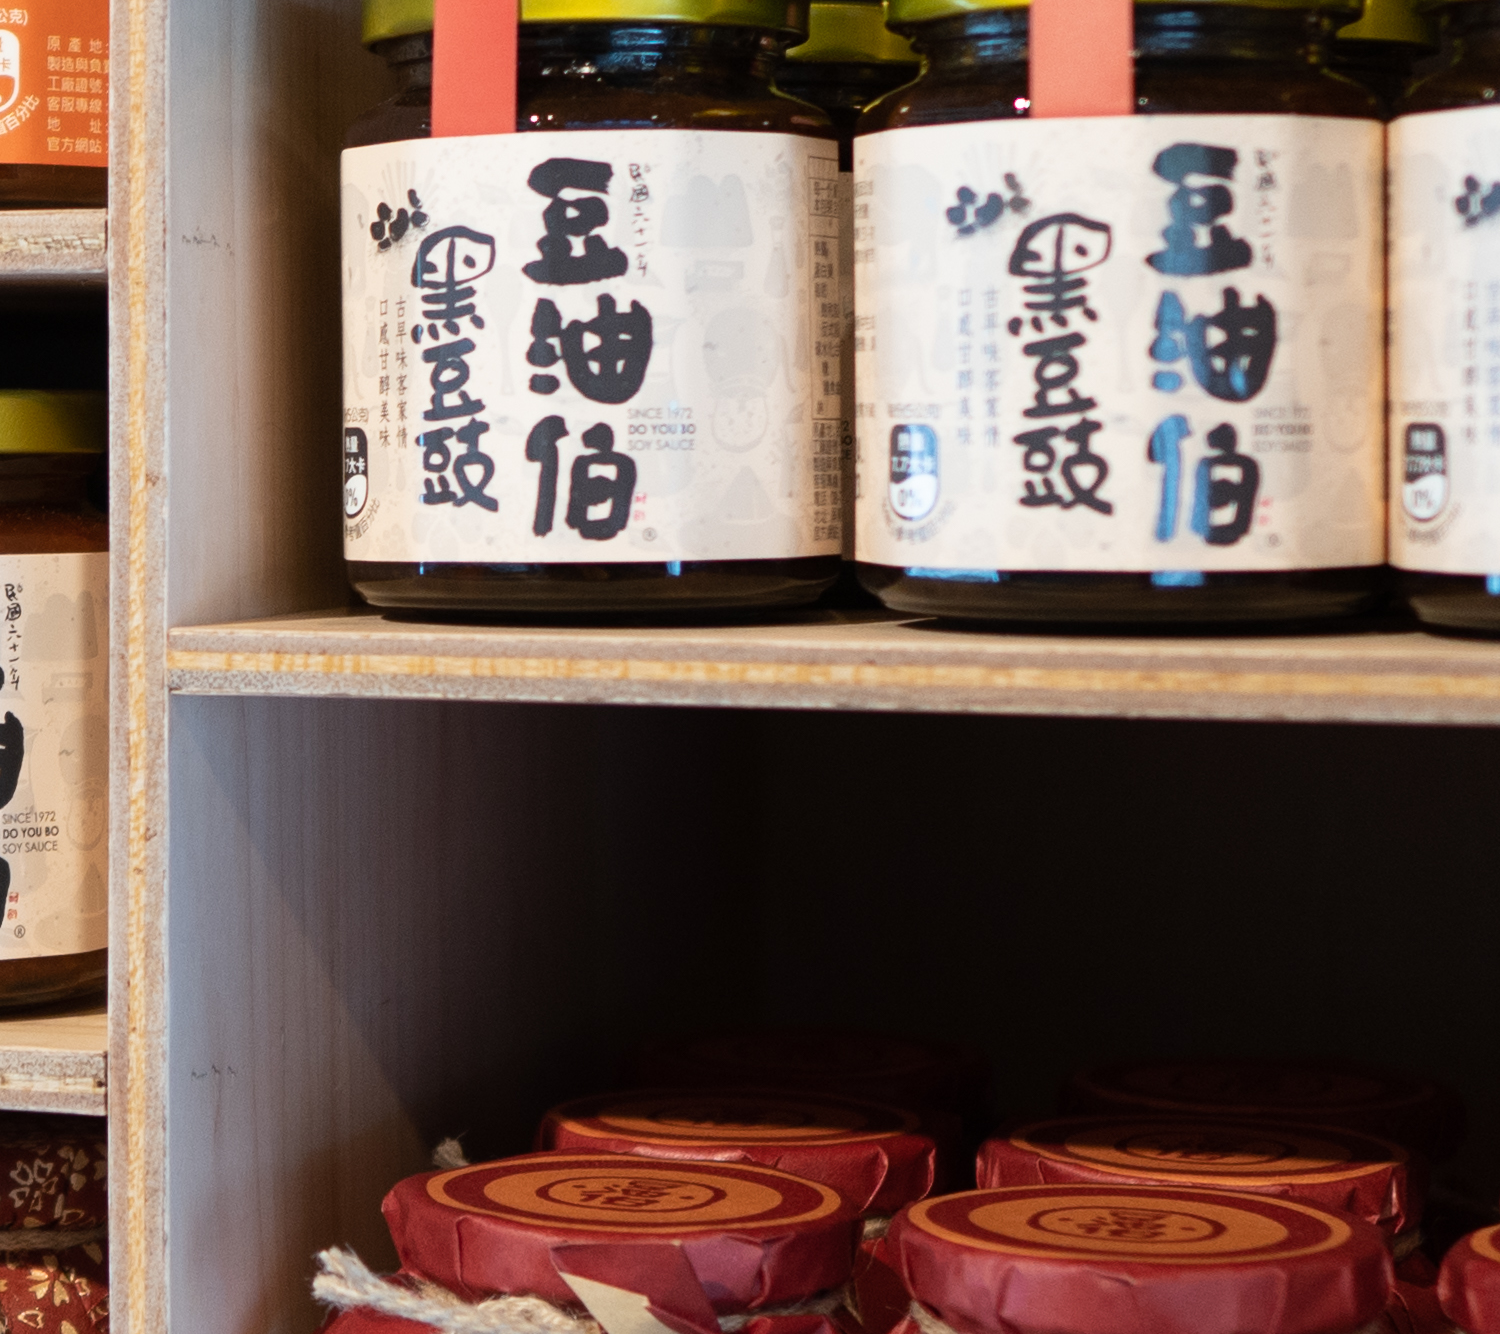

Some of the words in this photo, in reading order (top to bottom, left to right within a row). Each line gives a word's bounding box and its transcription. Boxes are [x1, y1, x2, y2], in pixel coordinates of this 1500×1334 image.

[378, 300, 391, 449] 口感甘醇美味
[395, 295, 408, 449] 古早味客家情
[411, 225, 498, 513] 黑豆豉
[522, 157, 653, 541] 豆油伯
[1007, 212, 1116, 516] 黑豆豉
[1145, 142, 1277, 546] 豆油伯
[627, 408, 664, 420] SINCE
[627, 424, 647, 435] DO
[651, 424, 678, 435] YOU
[627, 440, 653, 451] SOY
[656, 439, 695, 450] SAUCE
[2, 812, 31, 824] SINCE
[34, 811, 56, 822] 1972
[2, 842, 22, 854] SOY
[25, 841, 58, 853] SAUCE
[3, 828, 18, 839] DO
[21, 827, 42, 838] YOU
[45, 826, 59, 836] BO
